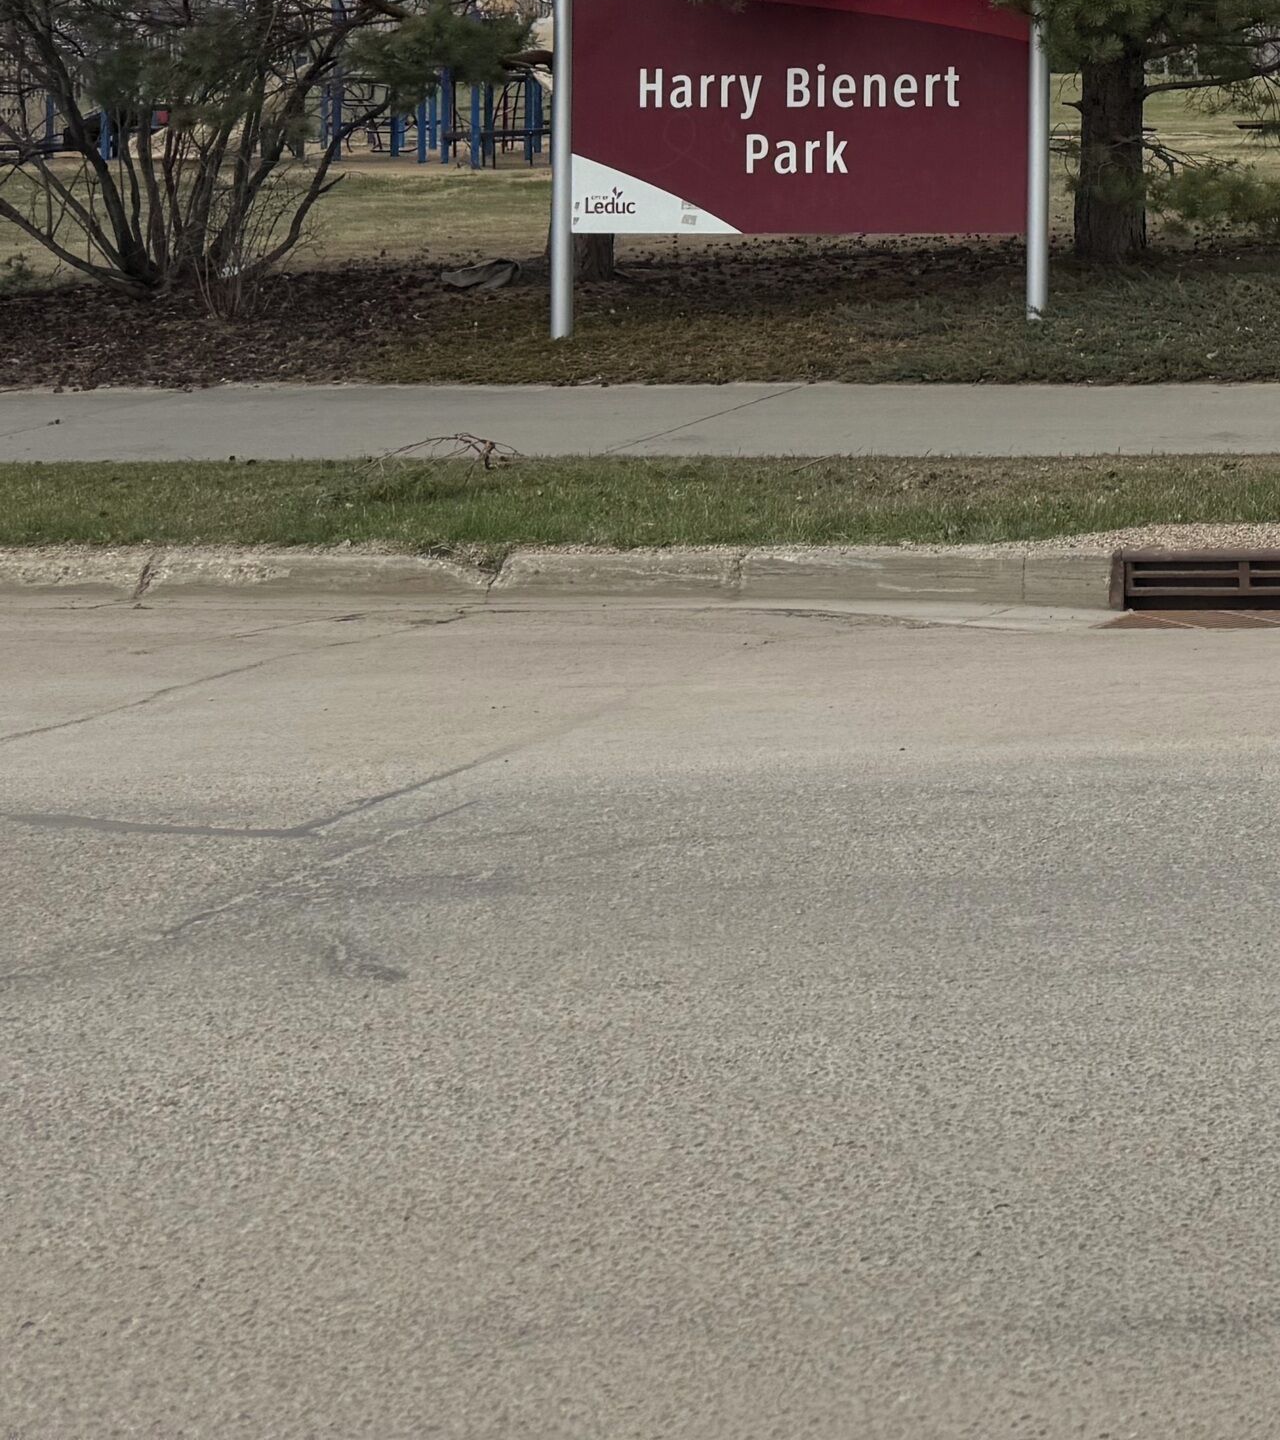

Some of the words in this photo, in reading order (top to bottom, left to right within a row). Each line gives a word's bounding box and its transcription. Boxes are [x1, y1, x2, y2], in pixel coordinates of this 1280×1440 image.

[640, 68, 762, 119] Harry
[786, 64, 960, 108] Bienert
[746, 131, 848, 174] Park
[584, 196, 636, 215] Leduc
